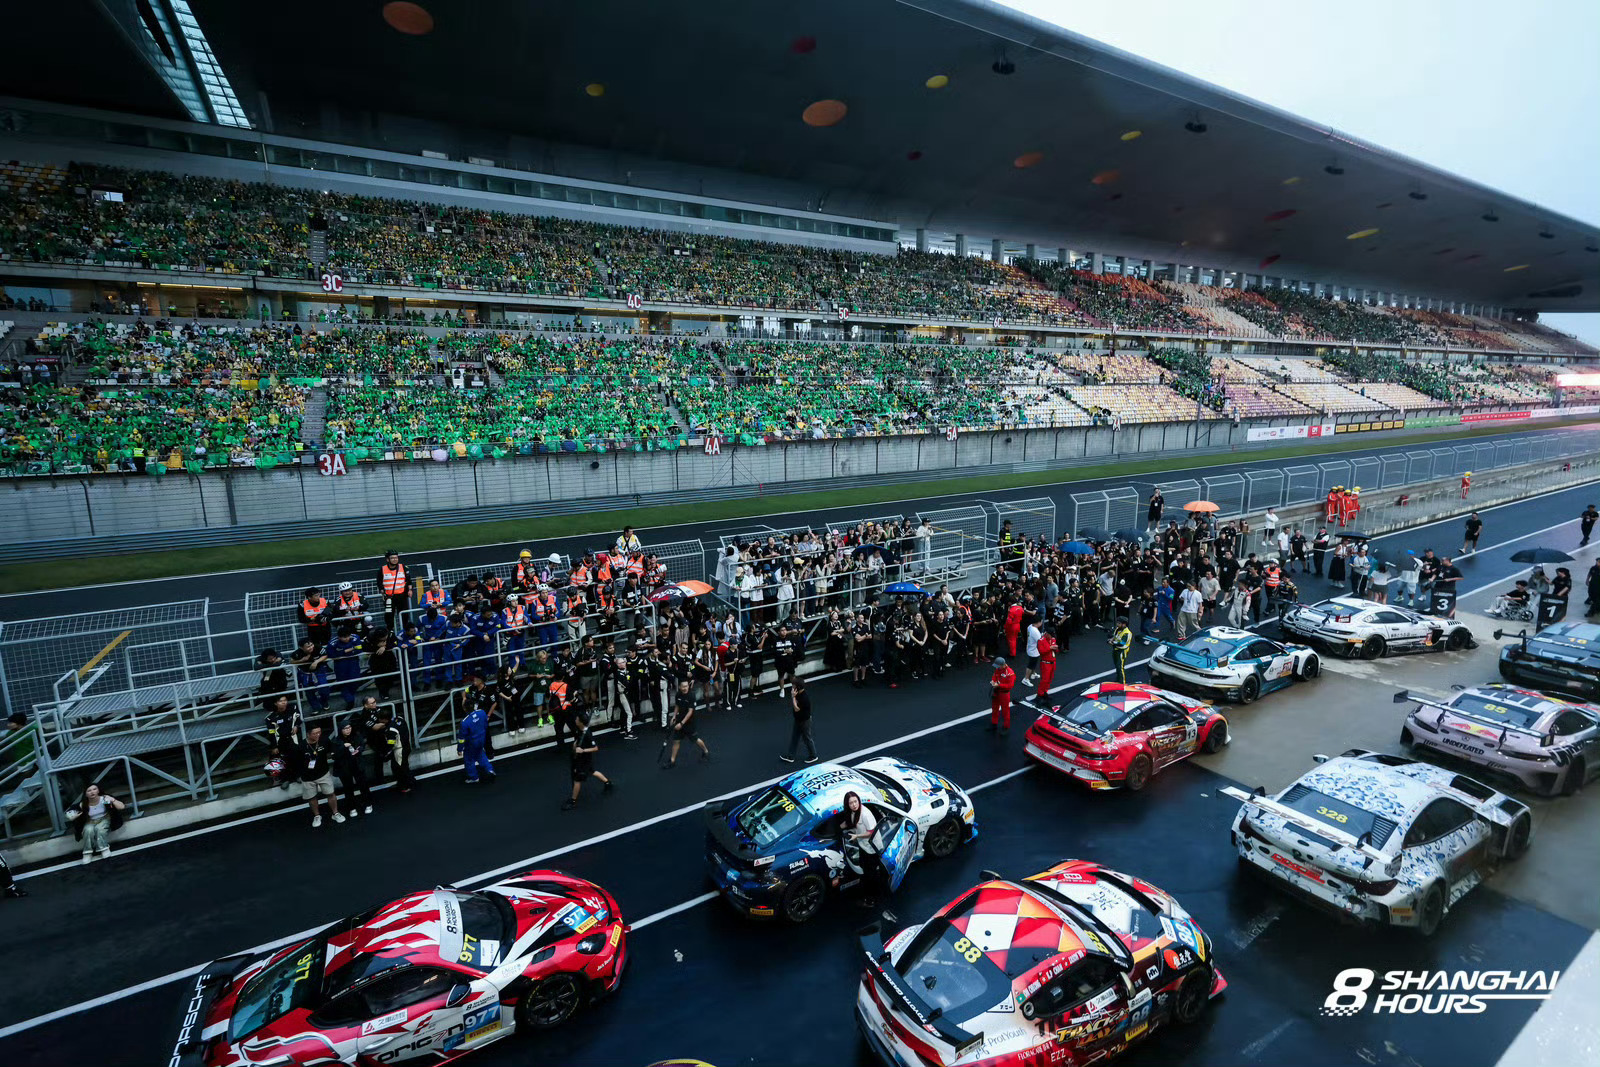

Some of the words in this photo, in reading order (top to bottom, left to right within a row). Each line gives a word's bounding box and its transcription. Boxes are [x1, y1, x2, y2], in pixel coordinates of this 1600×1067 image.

[322, 274, 343, 292] 3C
[627, 293, 641, 309] 4C
[838, 307, 849, 320] 5C
[993, 317, 1002, 328] 6C
[946, 426, 957, 441] 5A
[705, 437, 720, 455] 4A
[319, 453, 347, 476] 3A
[1436, 598, 1449, 611] 3
[1545, 604, 1558, 618] 1
[1091, 701, 1109, 711] 13
[1483, 703, 1509, 715] 85
[1187, 728, 1197, 740] 13
[1441, 737, 1485, 756] UNDEFEATED
[777, 795, 796, 813] 718
[1315, 804, 1349, 824] 328
[563, 907, 587, 926] 977
[446, 925, 457, 935] 8
[1174, 922, 1195, 948] 88
[460, 933, 478, 963] 977
[953, 937, 983, 964] 88
[293, 952, 313, 983] 977
[882, 972, 904, 996] GAZOO
[465, 1005, 499, 1029] 977
[903, 995, 928, 1025] TOYOTA
[1131, 1004, 1151, 1027] 88
[987, 1027, 1028, 1047] ProtYouth
[1050, 1047, 1067, 1063] EZZ
